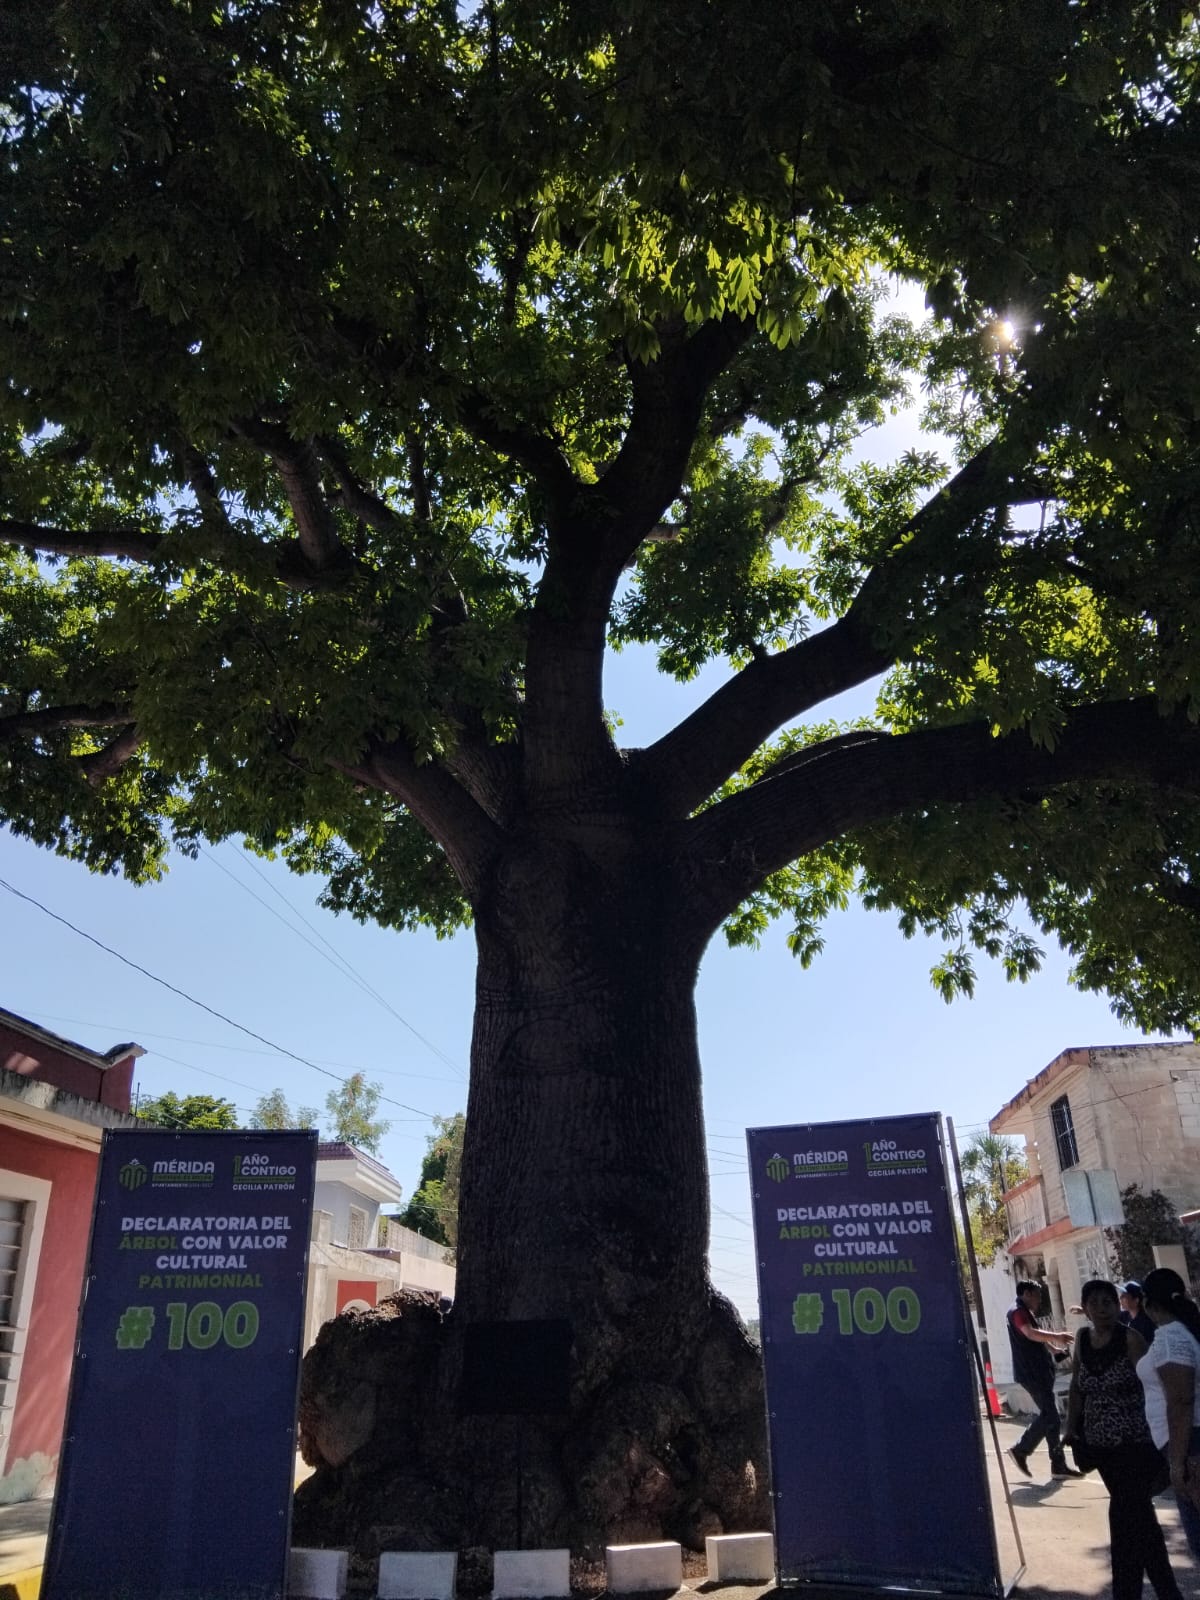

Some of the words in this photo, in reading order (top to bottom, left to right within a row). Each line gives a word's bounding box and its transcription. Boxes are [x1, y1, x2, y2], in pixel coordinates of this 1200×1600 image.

[872, 1139, 897, 1151] AÑO
[242, 1153, 270, 1165] AÑO
[793, 1149, 849, 1165] MÉRIDA
[872, 1149, 926, 1162] CONTIGO
[152, 1158, 215, 1173] MÉRIDA
[241, 1165, 297, 1176] CONTIGO
[867, 1169, 896, 1177] CECILIA
[896, 1166, 928, 1175] PATRÓN
[232, 1183, 262, 1191] CECILIA
[263, 1182, 295, 1190] PATRÓN
[777, 1205, 901, 1222] DECLARATORIA
[903, 1200, 933, 1215] DEL
[121, 1217, 258, 1231] DECLARATORIA
[261, 1216, 292, 1230] DEL
[779, 1222, 831, 1240] ÁRBOL
[832, 1223, 870, 1237] CON
[875, 1219, 933, 1235] VALOR
[119, 1233, 178, 1250] ÁRBOL
[182, 1236, 222, 1250] CON
[228, 1235, 288, 1249] VALOR
[814, 1240, 899, 1257] CULTURAL
[156, 1255, 248, 1269] CULTURAL
[803, 1258, 919, 1277] PATRIMONIAL
[138, 1274, 264, 1289] PATRIMONIAL
